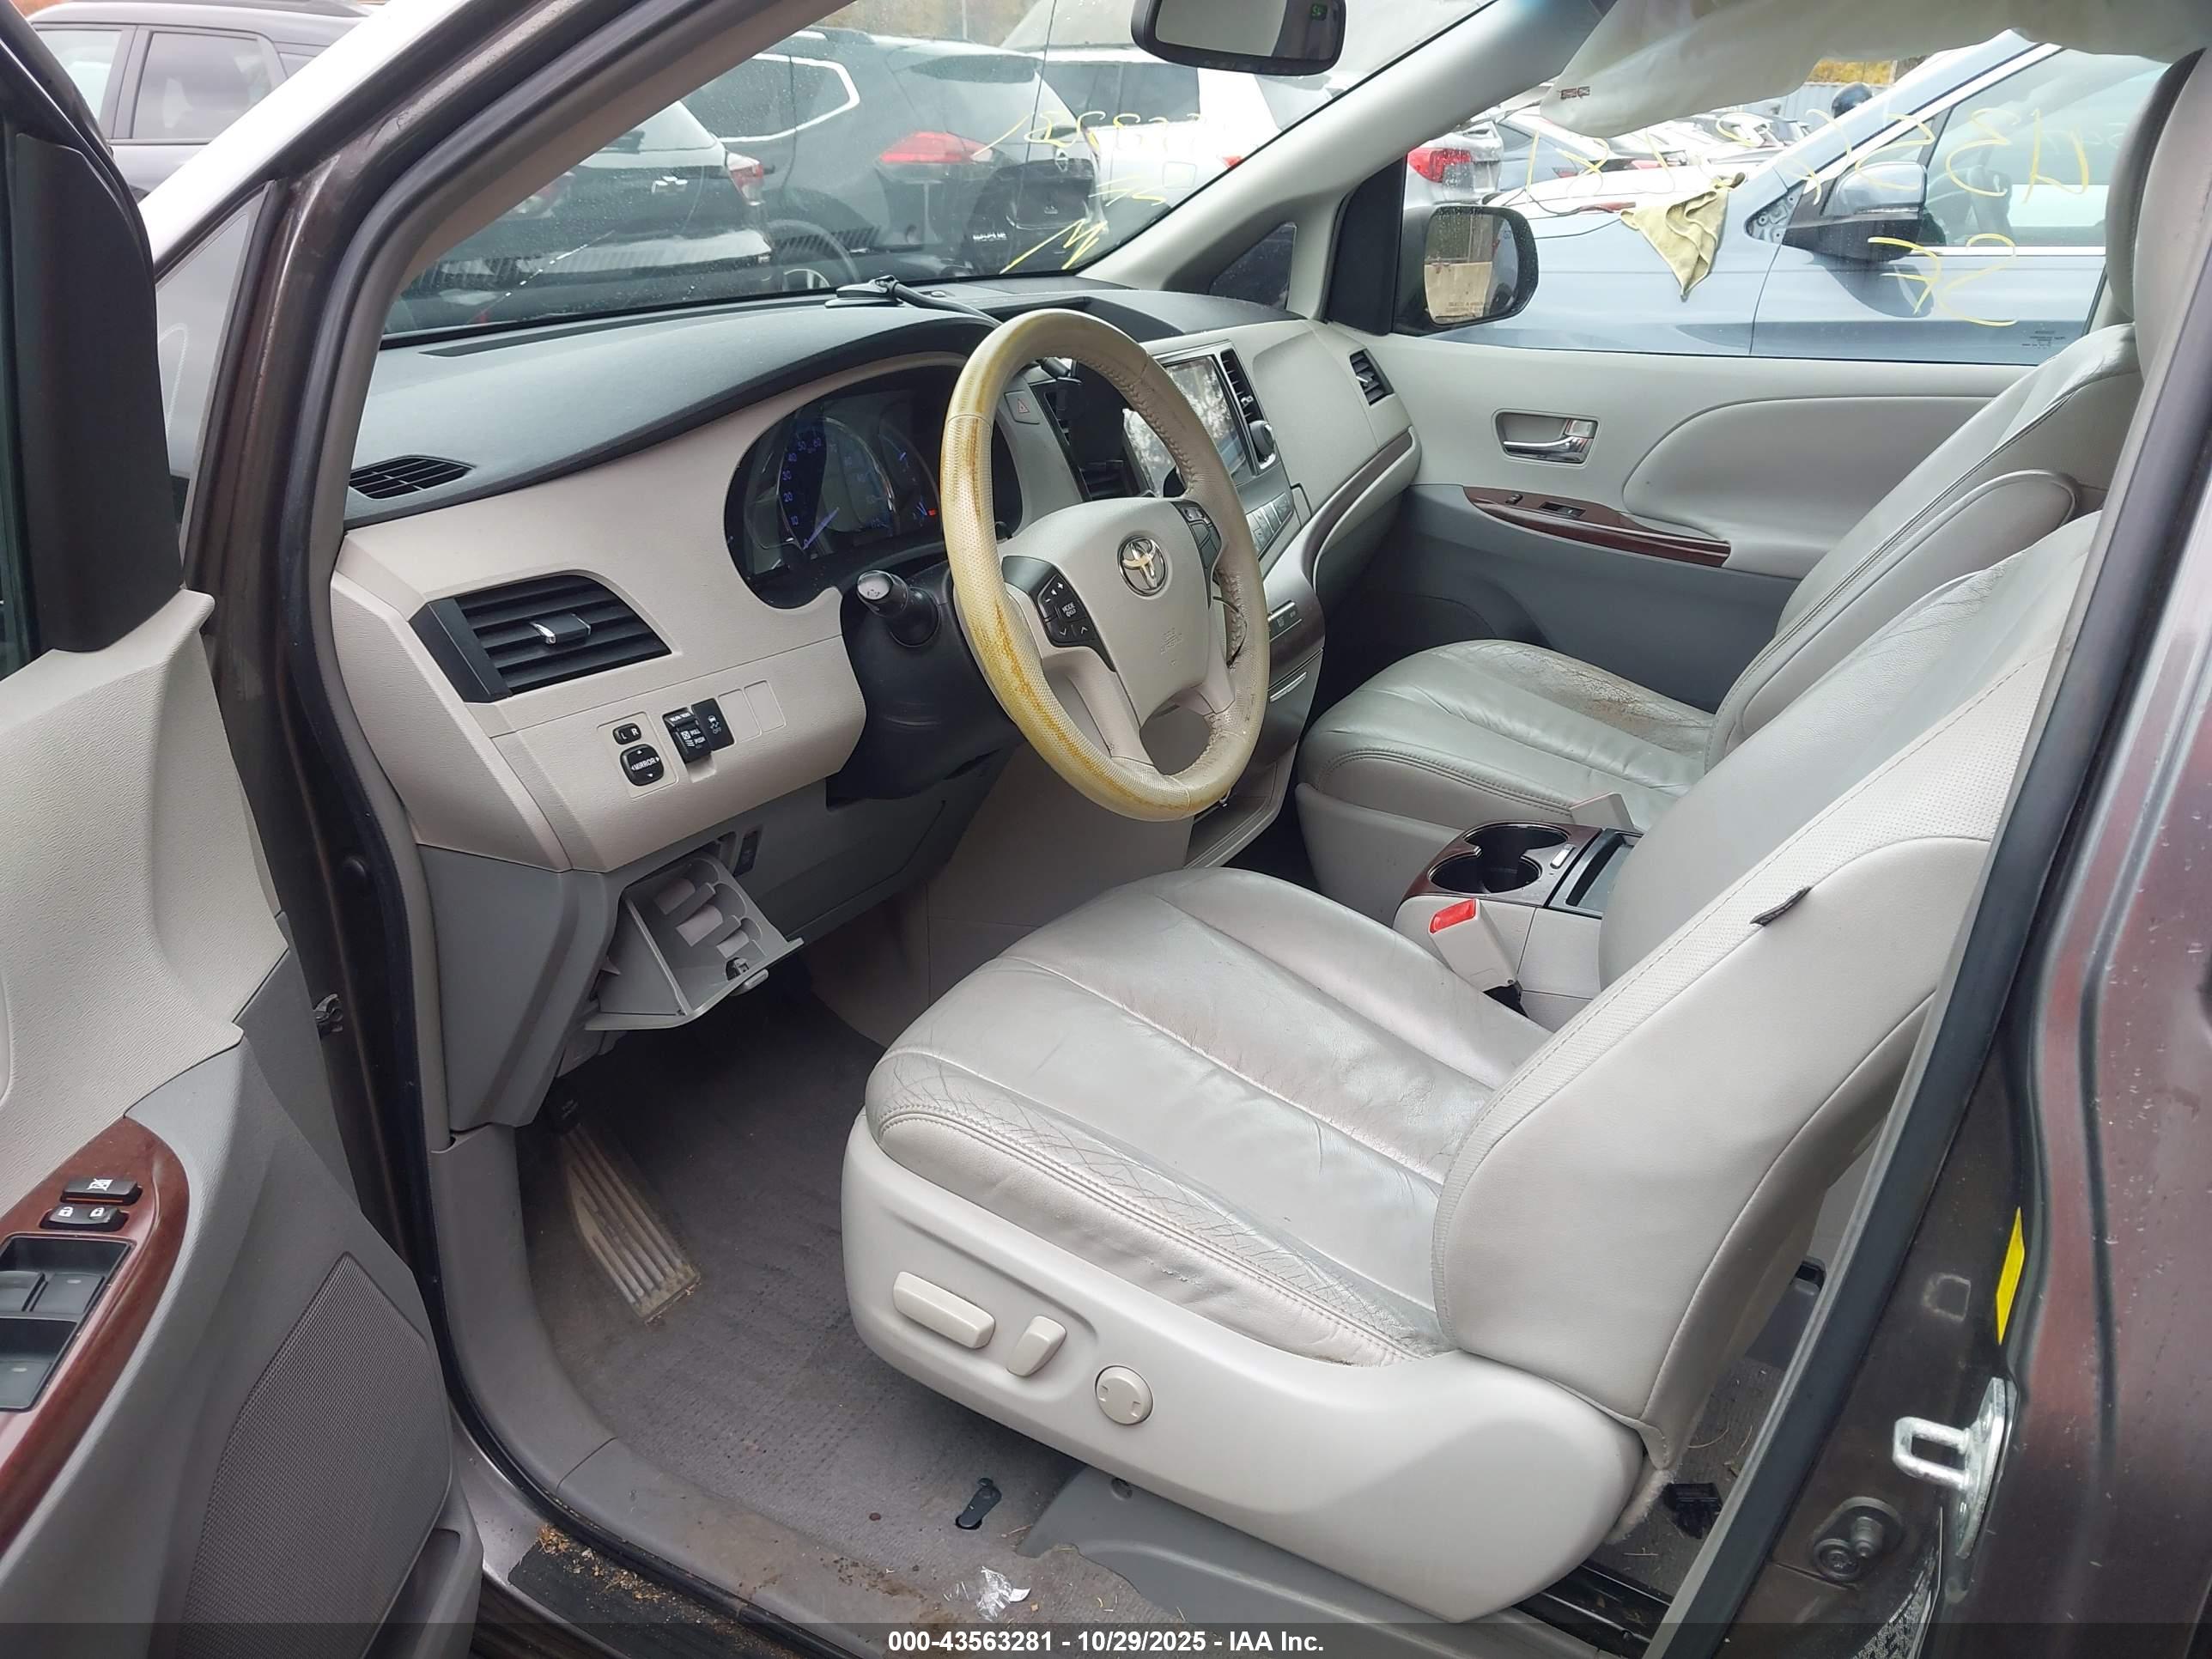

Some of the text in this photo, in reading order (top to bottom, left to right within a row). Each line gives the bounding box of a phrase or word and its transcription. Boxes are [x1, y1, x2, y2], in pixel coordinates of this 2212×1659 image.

[620, 727, 639, 740] L R
[633, 757, 657, 771] MIRROR
